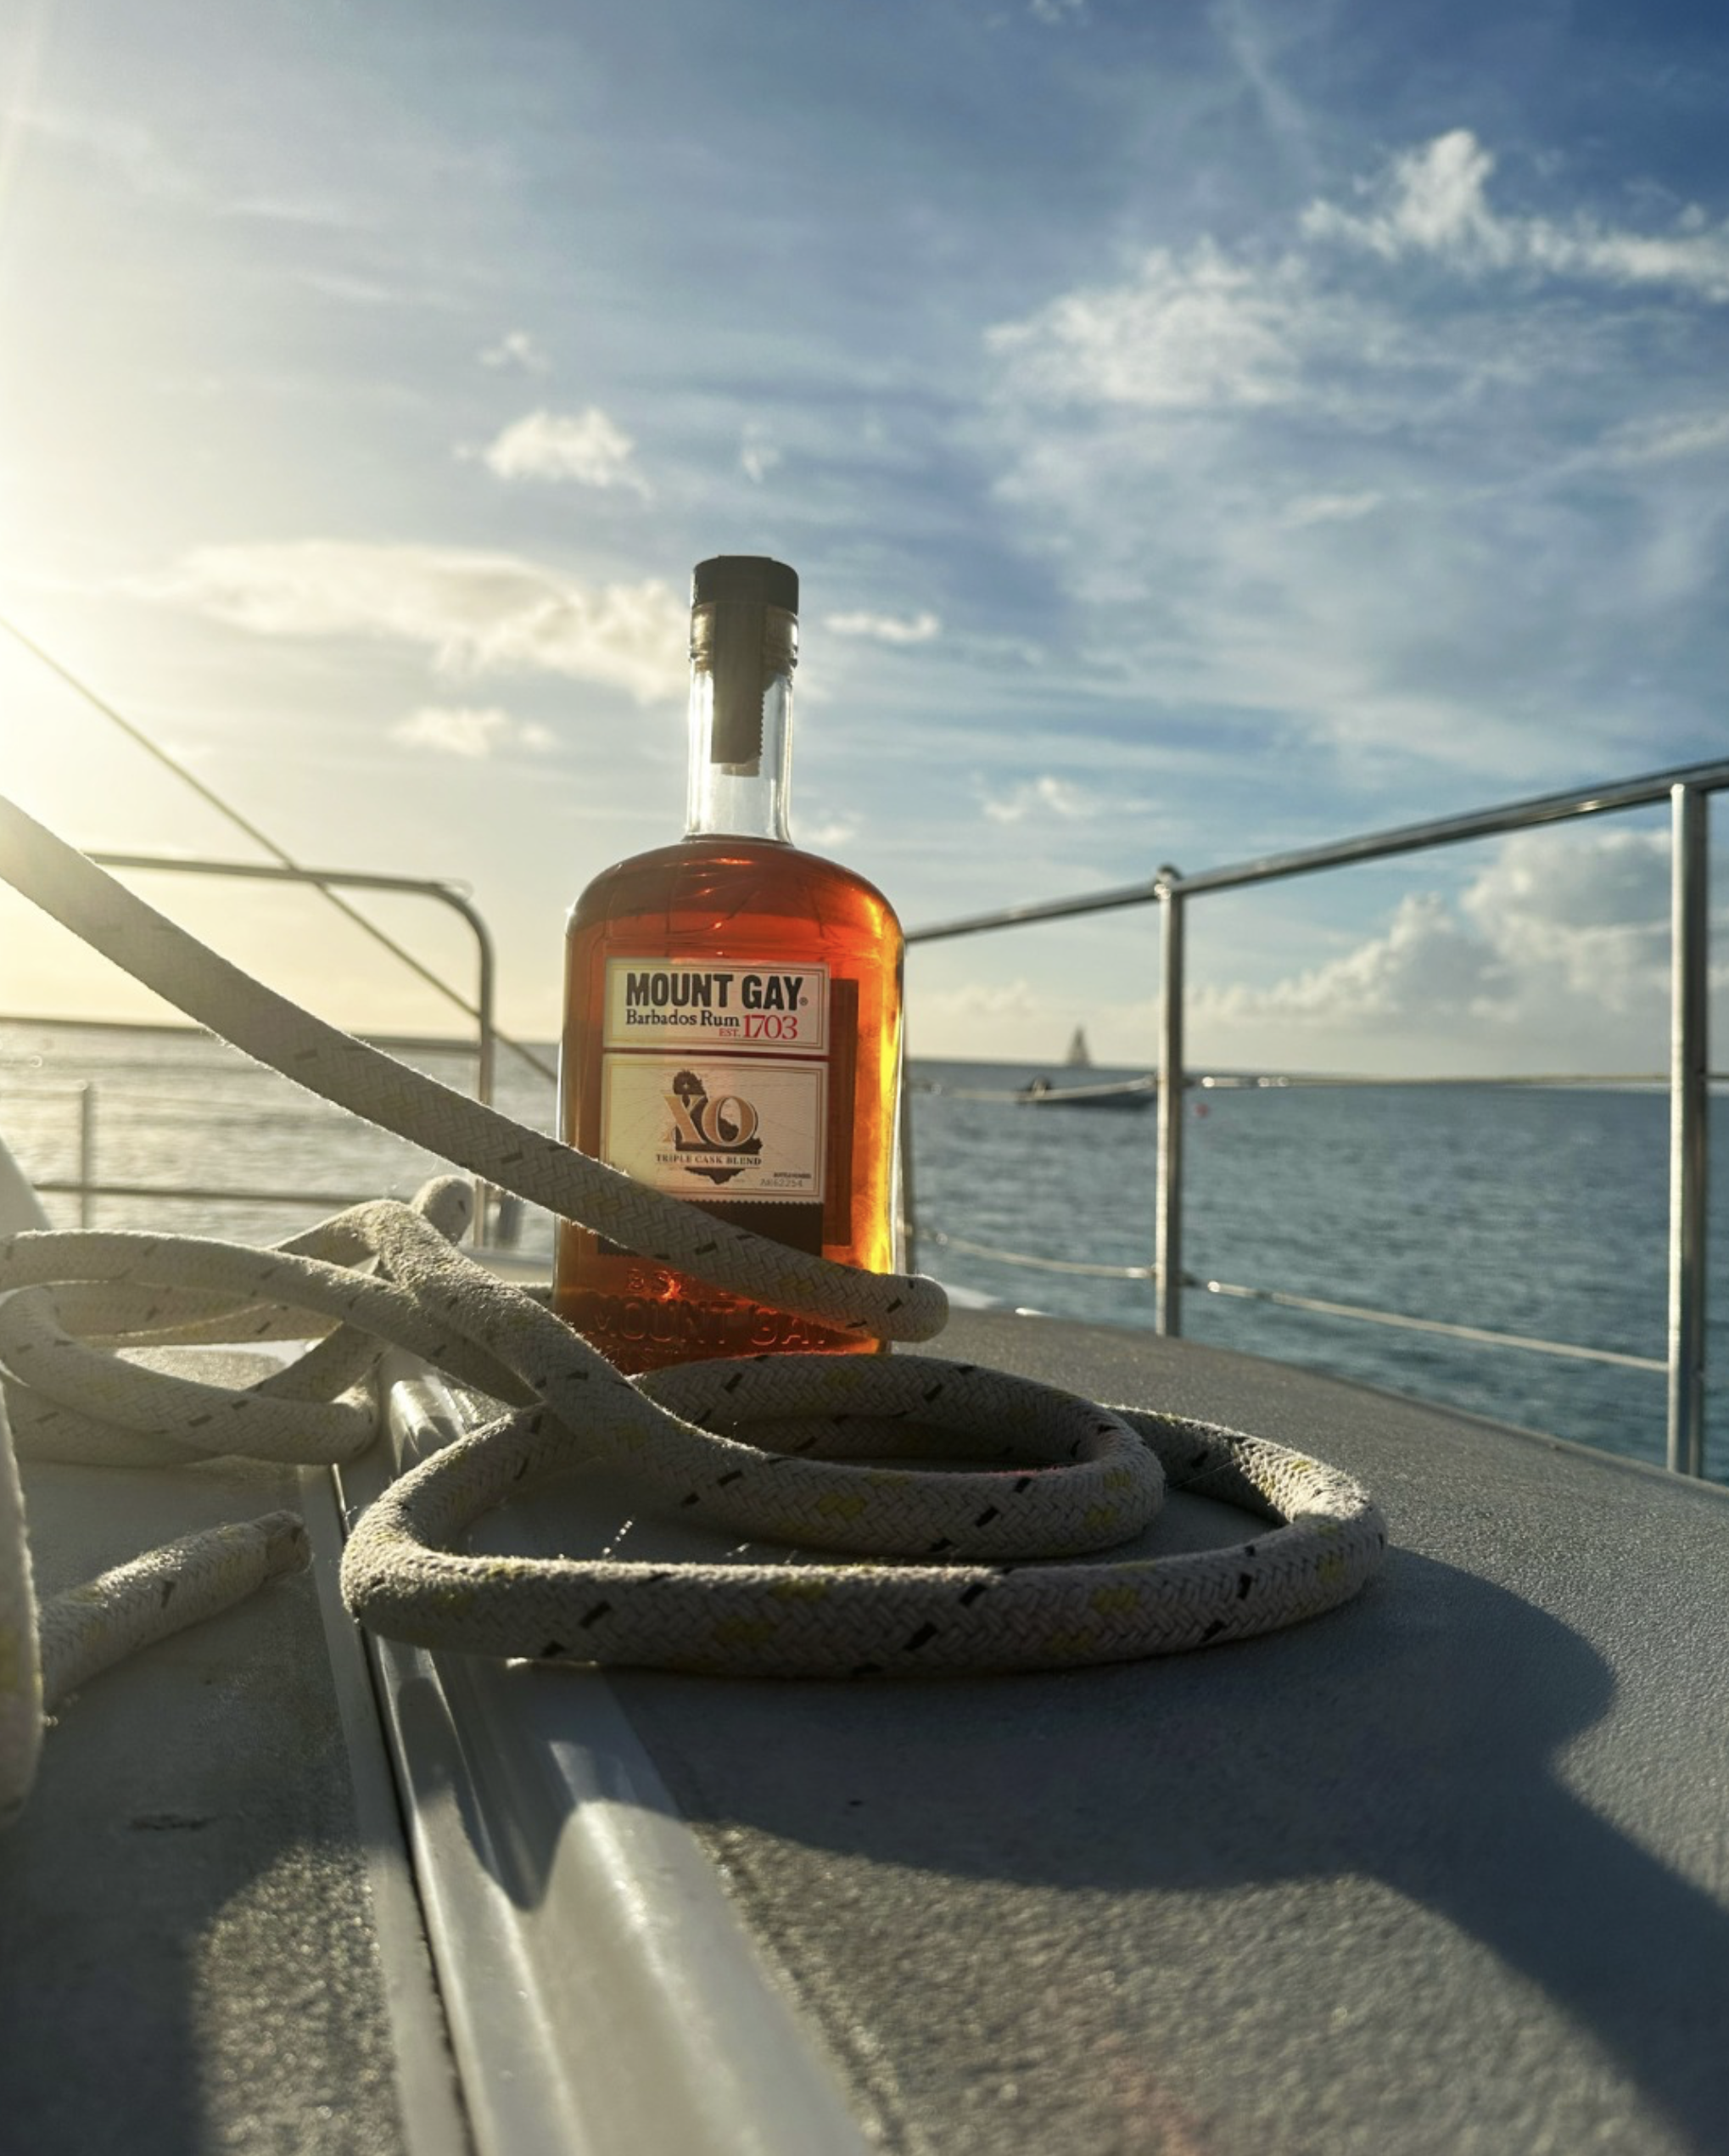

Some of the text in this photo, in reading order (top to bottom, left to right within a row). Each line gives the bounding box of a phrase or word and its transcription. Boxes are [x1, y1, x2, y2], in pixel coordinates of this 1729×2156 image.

[626, 972, 734, 1007] MOUNT
[626, 1009, 740, 1027] Barbados Rum
[719, 1013, 798, 1039] EST. 1703
[663, 1094, 758, 1146] XO
[656, 1153, 762, 1166] TRIPLE CASK BLEND
